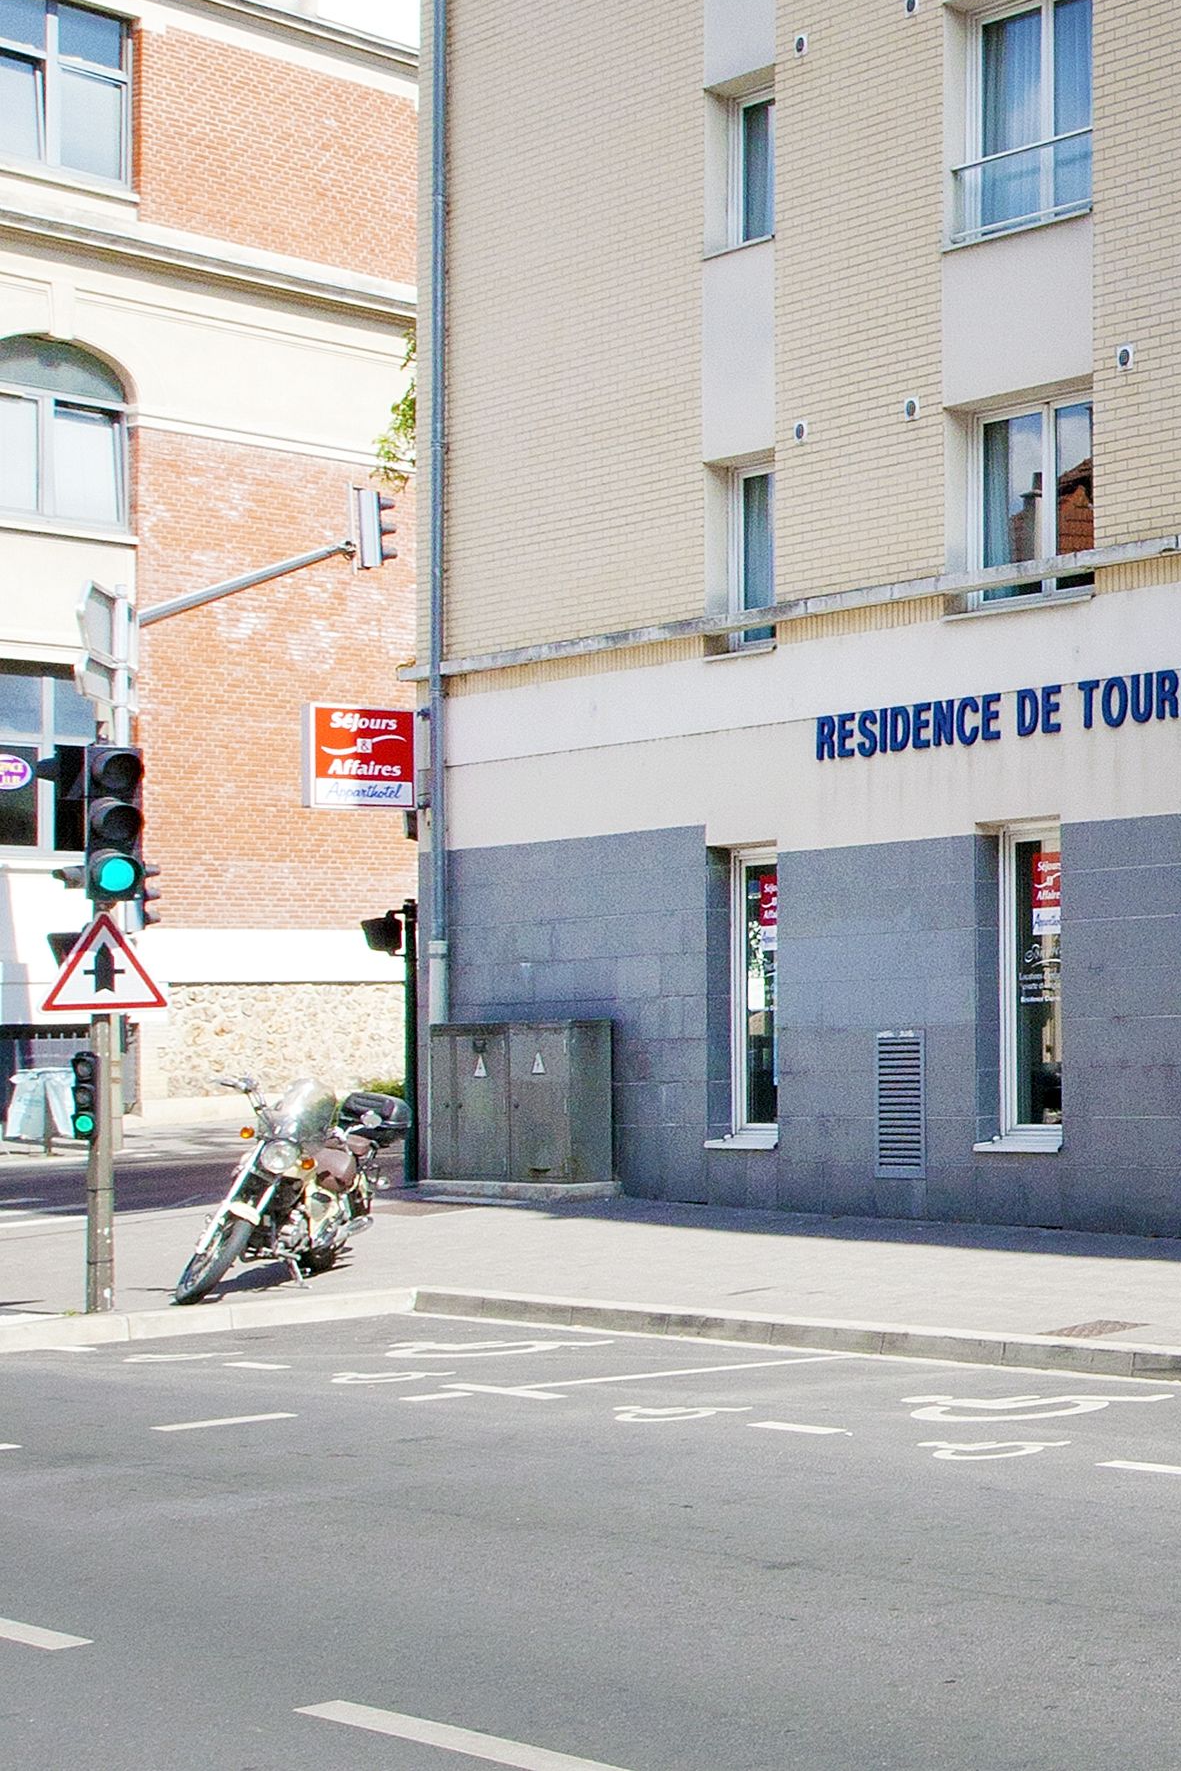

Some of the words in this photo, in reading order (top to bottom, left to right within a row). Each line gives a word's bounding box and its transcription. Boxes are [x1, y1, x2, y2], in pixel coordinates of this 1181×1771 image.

[330, 711, 398, 732] Séjours
[816, 693, 1001, 761] RESIDENCE
[1016, 684, 1063, 737] DE
[327, 758, 402, 777] Affaires
